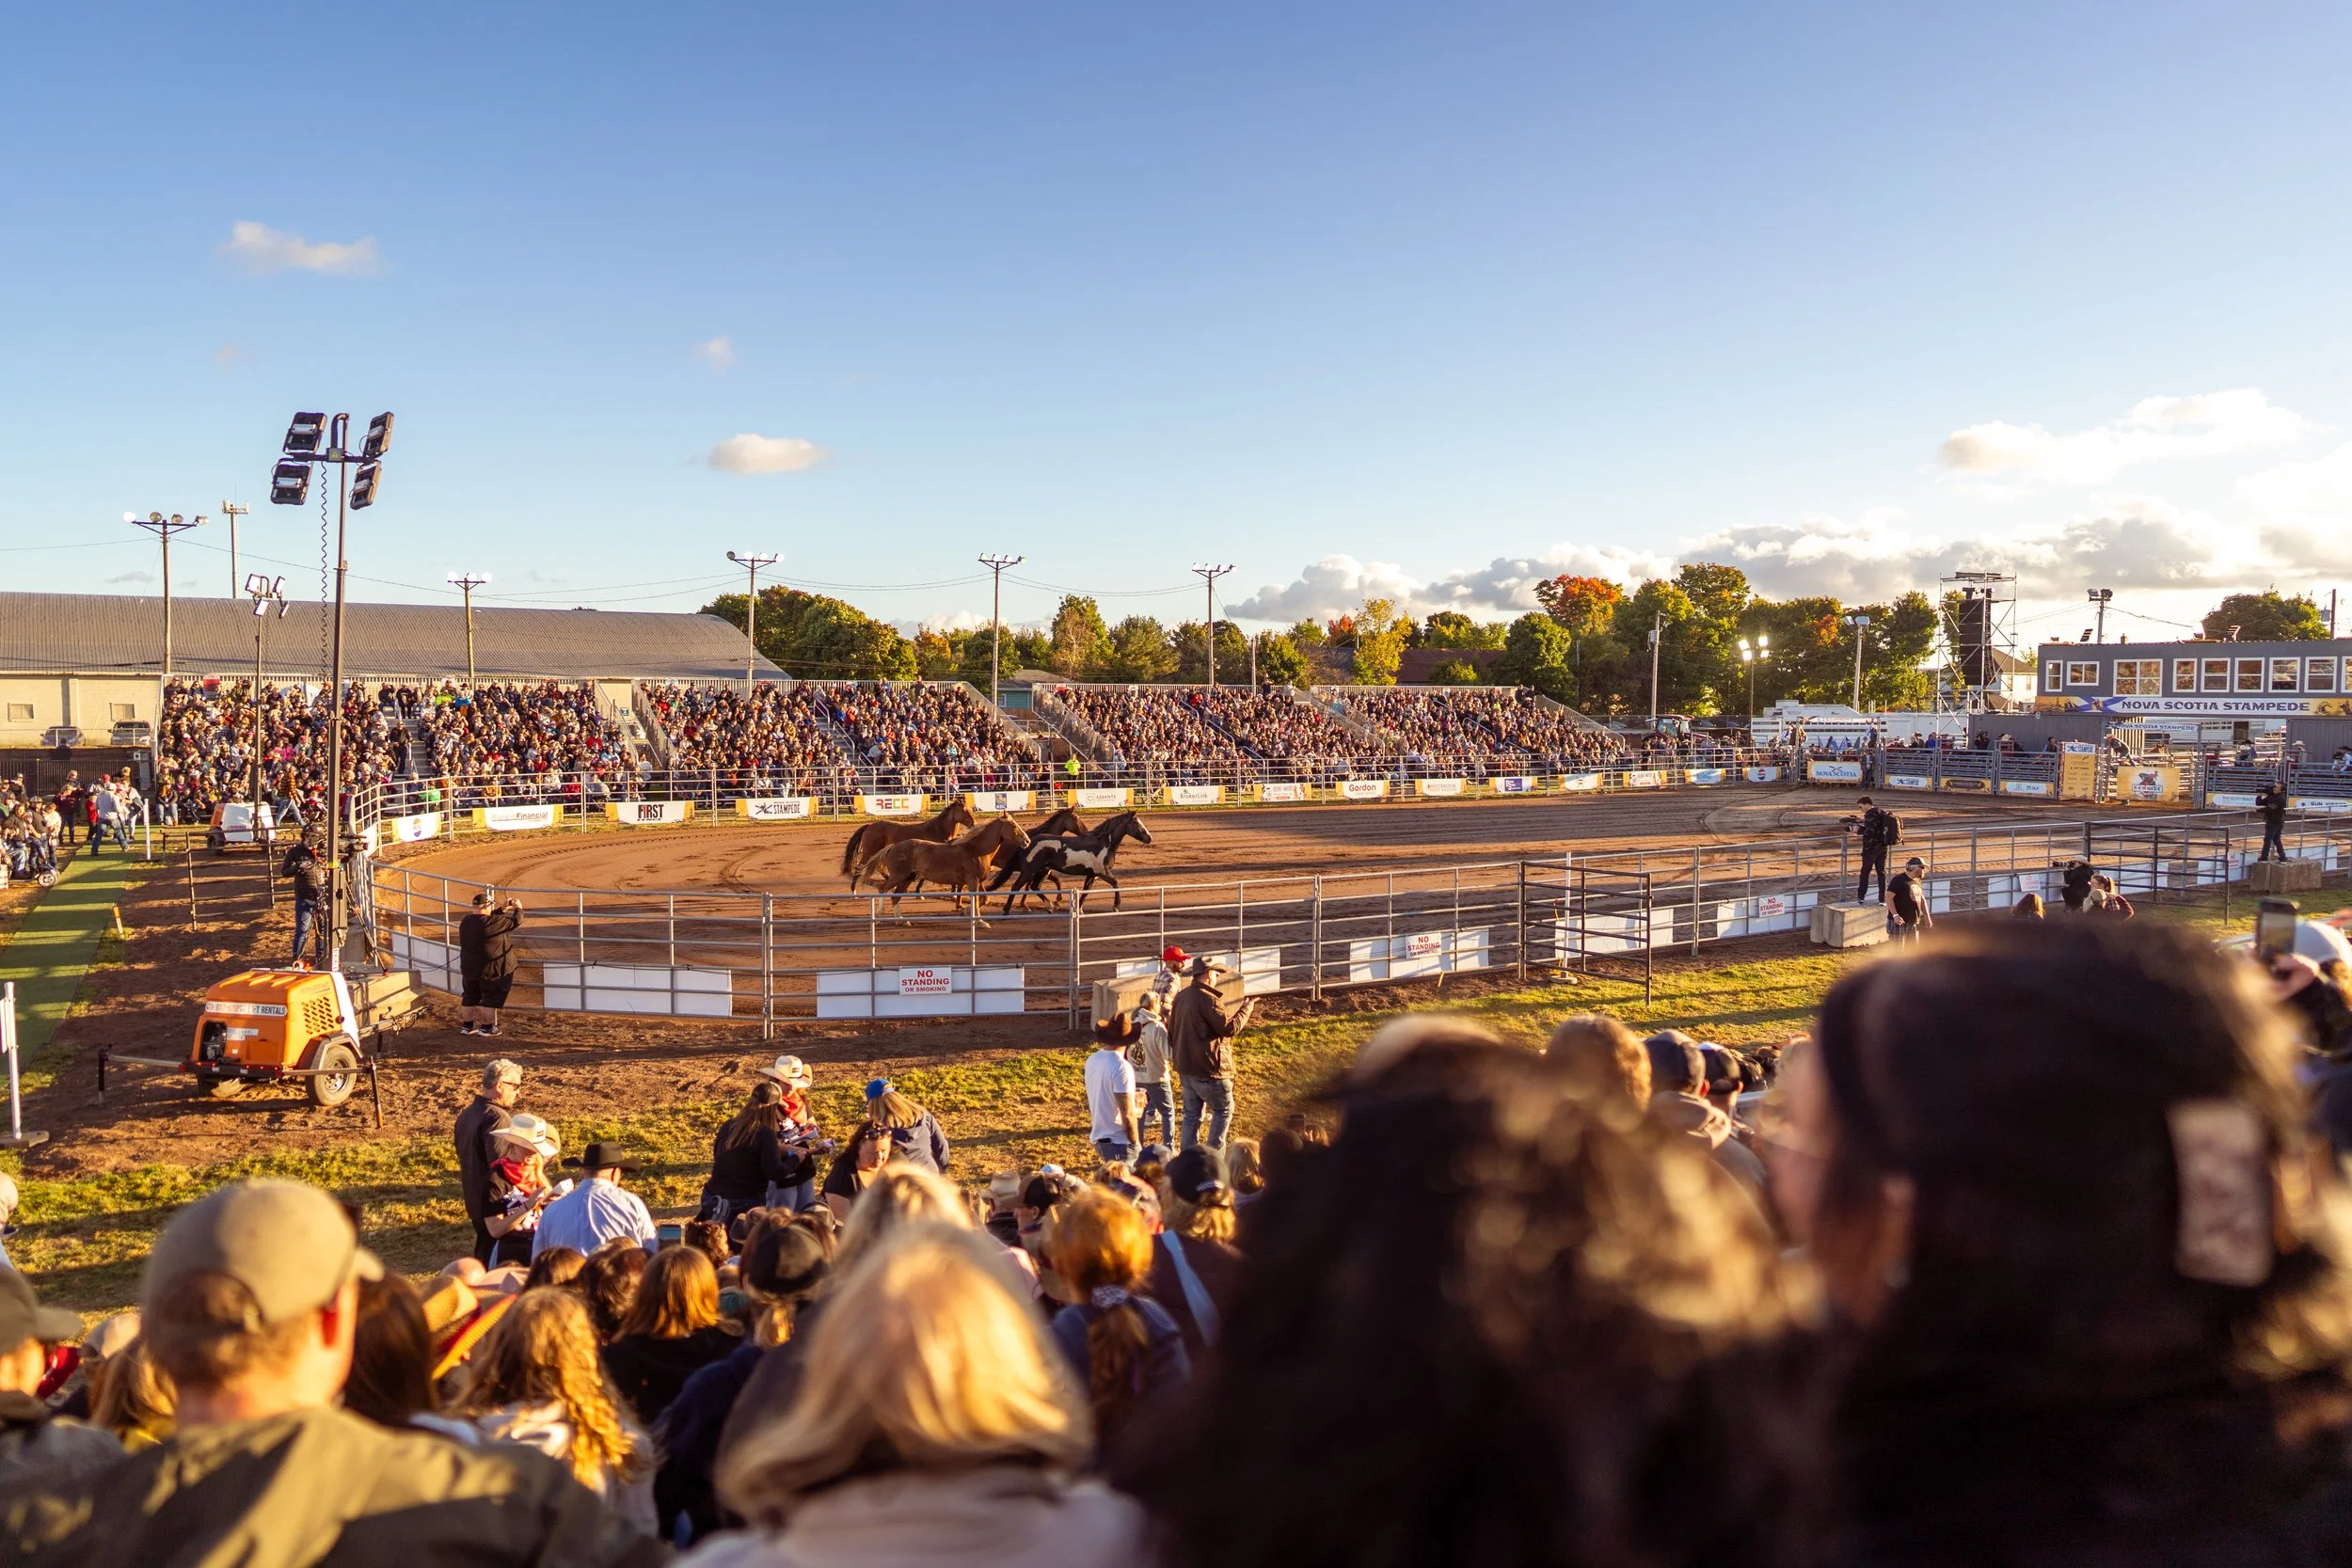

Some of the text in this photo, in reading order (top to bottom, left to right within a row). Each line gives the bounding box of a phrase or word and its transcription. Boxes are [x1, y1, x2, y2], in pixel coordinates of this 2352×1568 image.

[2122, 701, 2310, 711] NOVA SCOTIA STAMPEDE
[1348, 784, 1376, 792] Gordon
[876, 798, 910, 810] RECC
[773, 804, 801, 815] STAMPEDE
[1407, 942, 1440, 951] STANDING
[261, 1006, 286, 1015] RENTALS
